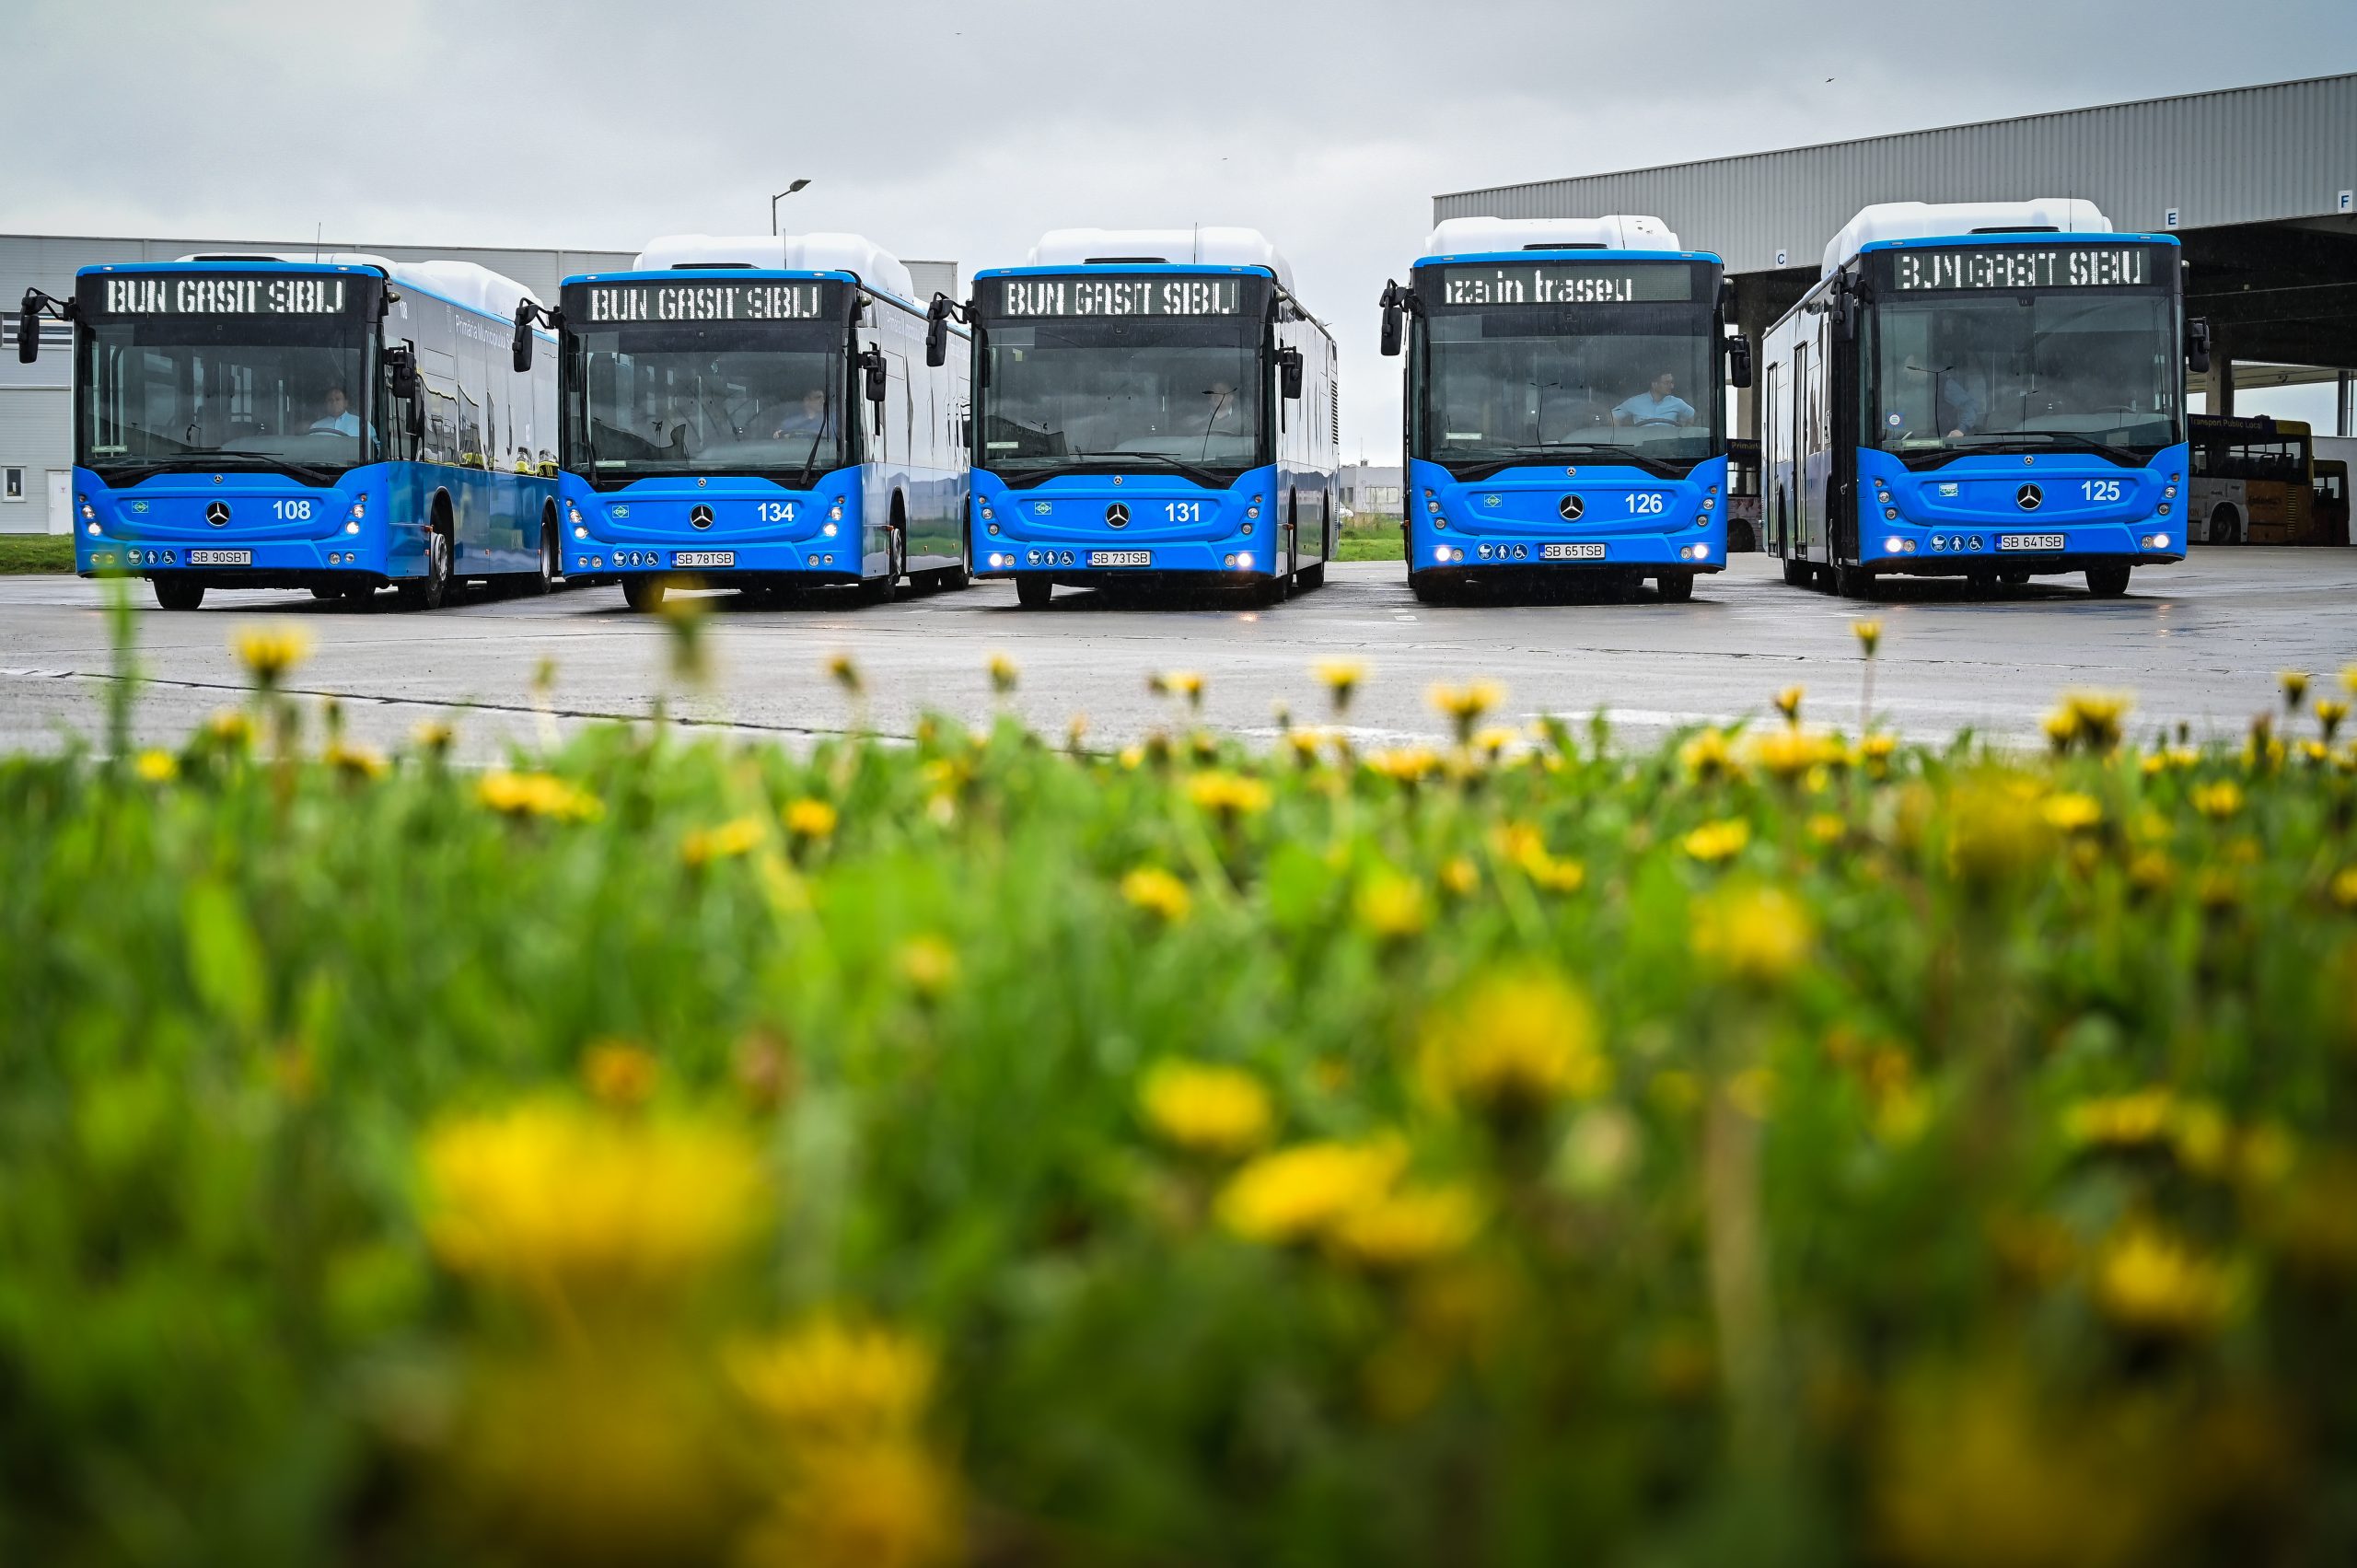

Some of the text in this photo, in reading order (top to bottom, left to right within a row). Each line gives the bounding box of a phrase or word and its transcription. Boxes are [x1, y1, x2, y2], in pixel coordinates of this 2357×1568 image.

[2340, 194, 2350, 208] F
[2167, 212, 2177, 226] E
[1777, 253, 1785, 264] C
[108, 280, 167, 313] BUN
[177, 280, 262, 313] GASIT
[1497, 270, 1524, 304] in
[591, 288, 647, 320] BUN
[658, 288, 740, 319] GASIT
[1007, 282, 1065, 316] BUN
[399, 300, 409, 320] 108
[2189, 416, 2263, 430] Transport Public Local
[2081, 481, 2120, 501] 125
[273, 500, 311, 520] 108
[757, 503, 795, 522] 134
[1165, 502, 1201, 522] 131
[1625, 494, 1663, 514] 126
[1545, 545, 1602, 557] SB 65TSB
[2003, 536, 2061, 548] SB 64TSB
[192, 552, 208, 563] SB
[212, 552, 249, 563] 90SBT
[678, 553, 732, 564] SB 78TSB
[1093, 553, 1109, 563] SB
[1112, 552, 1148, 563] 73TSB
